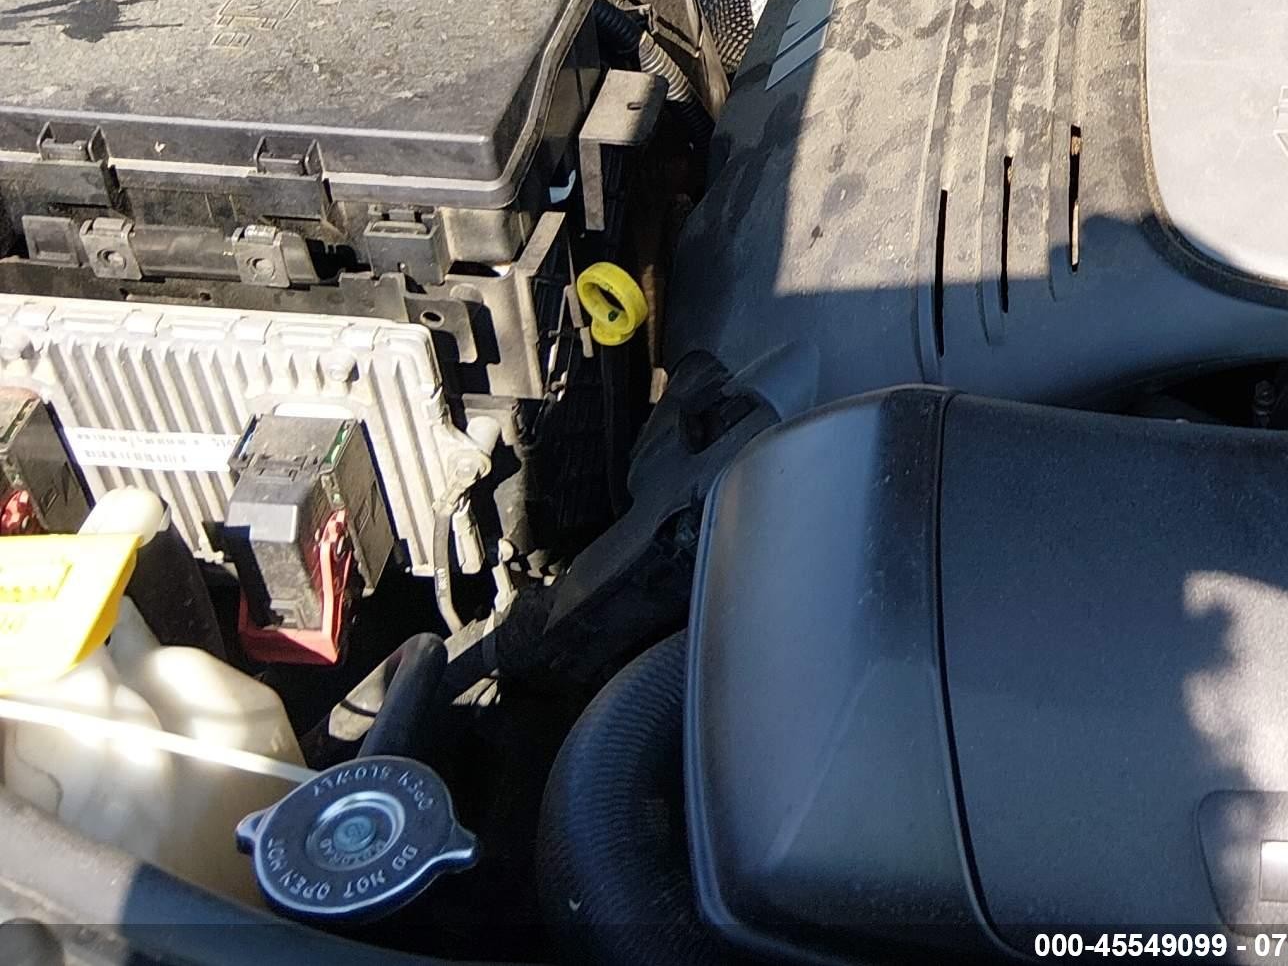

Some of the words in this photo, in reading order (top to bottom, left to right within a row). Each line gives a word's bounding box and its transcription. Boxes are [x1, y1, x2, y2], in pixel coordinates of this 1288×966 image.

[391, 843, 420, 872] DO
[278, 867, 332, 901] OPEN
[342, 869, 388, 900] NOT
